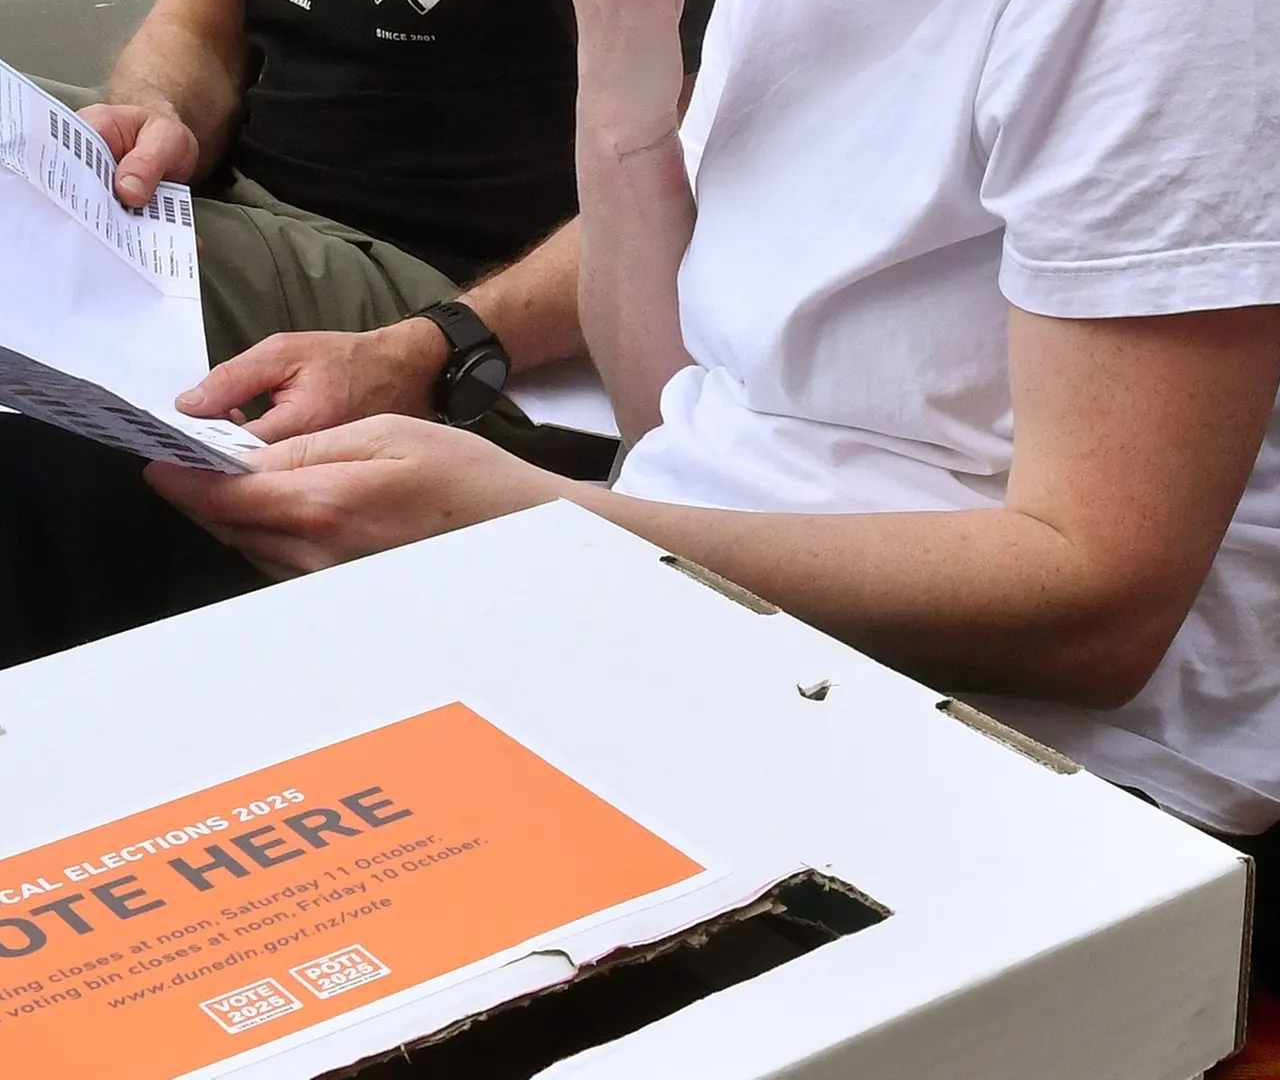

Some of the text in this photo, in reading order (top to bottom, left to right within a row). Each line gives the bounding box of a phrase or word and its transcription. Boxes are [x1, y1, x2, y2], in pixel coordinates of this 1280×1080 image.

[375, 27, 436, 42] SINCE 2001
[62, 816, 230, 882] ELECTIONS
[231, 788, 305, 822] 2025
[166, 785, 414, 892] HERE
[6, 985, 82, 1018] voting
[83, 970, 123, 991] bin
[127, 944, 203, 976] closes
[207, 930, 232, 947] at
[296, 880, 368, 914] Friday
[369, 867, 399, 883] 10
[401, 835, 489, 873] October.
[47, 951, 124, 983] closes
[128, 939, 153, 955] at
[220, 878, 320, 921] Saturday
[323, 866, 351, 881] 11
[107, 895, 393, 1009] www.dunedin.govt.nz/vote
[212, 983, 275, 1013] VOTE
[227, 994, 286, 1025] 2025
[317, 961, 375, 990] 2025
